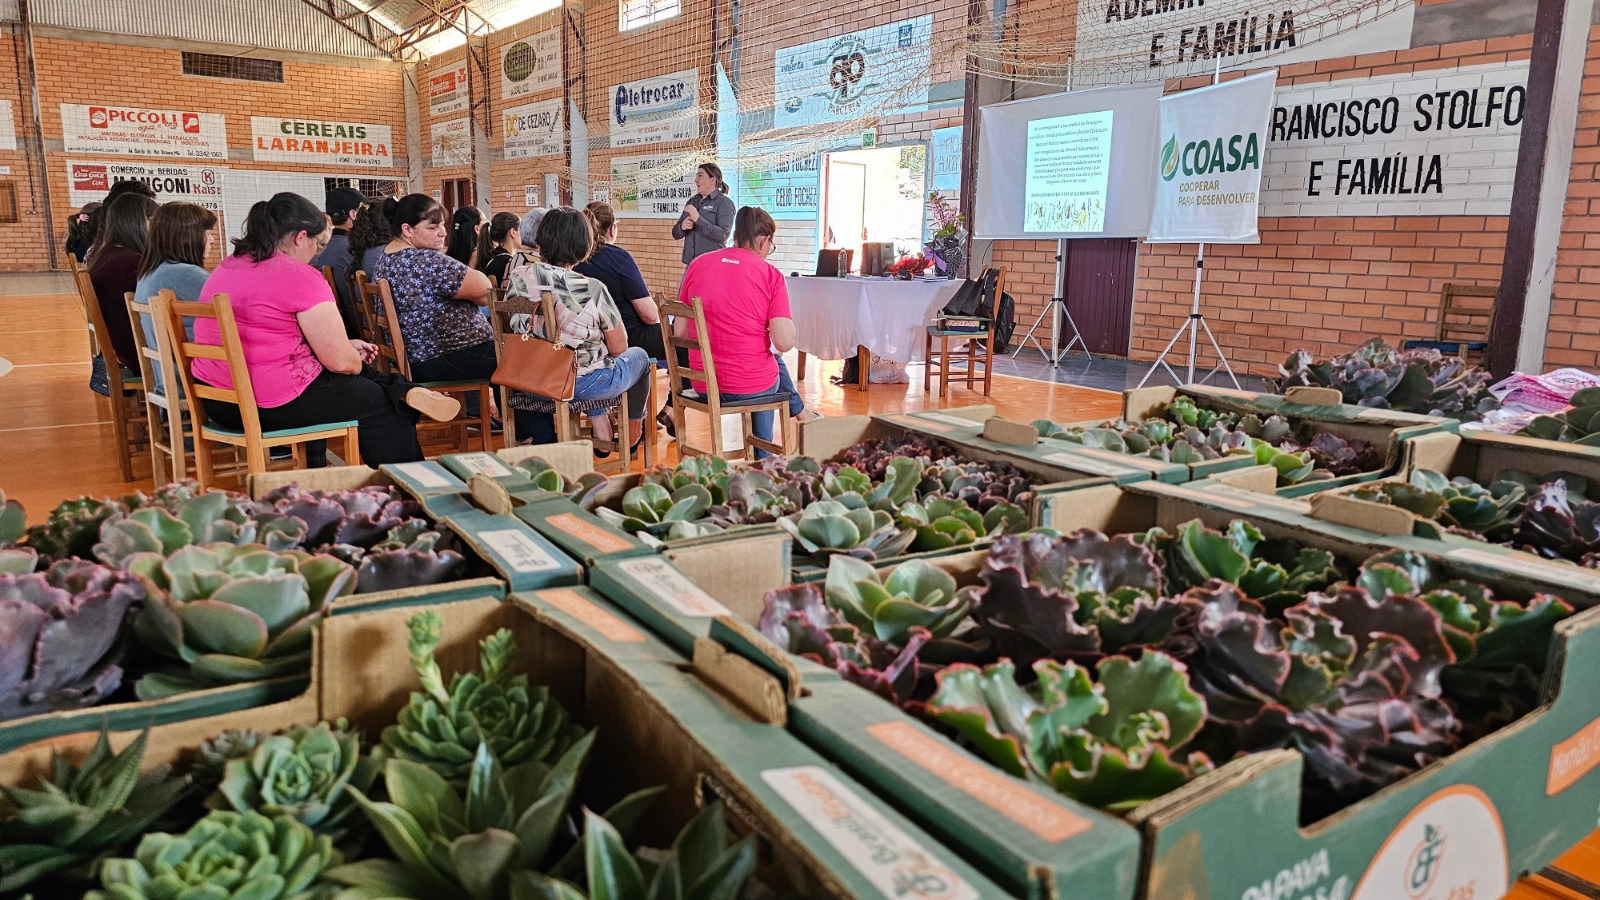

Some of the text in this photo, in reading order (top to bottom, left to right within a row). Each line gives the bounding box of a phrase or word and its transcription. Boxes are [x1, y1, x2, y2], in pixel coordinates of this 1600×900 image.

[1178, 10, 1296, 62] FAMÍLIA
[108, 109, 177, 124] PICCOLI
[1269, 85, 1526, 142] RANCISCO STOLFO
[280, 121, 367, 139] CEREAIS
[257, 136, 389, 157] LARANJEIRA
[1181, 132, 1260, 177] COASA
[157, 167, 188, 176] BEBIDAS
[1307, 151, 1443, 196] E FAMÍLIA
[1179, 180, 1220, 193] COOPERAR
[1178, 191, 1256, 207] PARA DESENVOLVER
